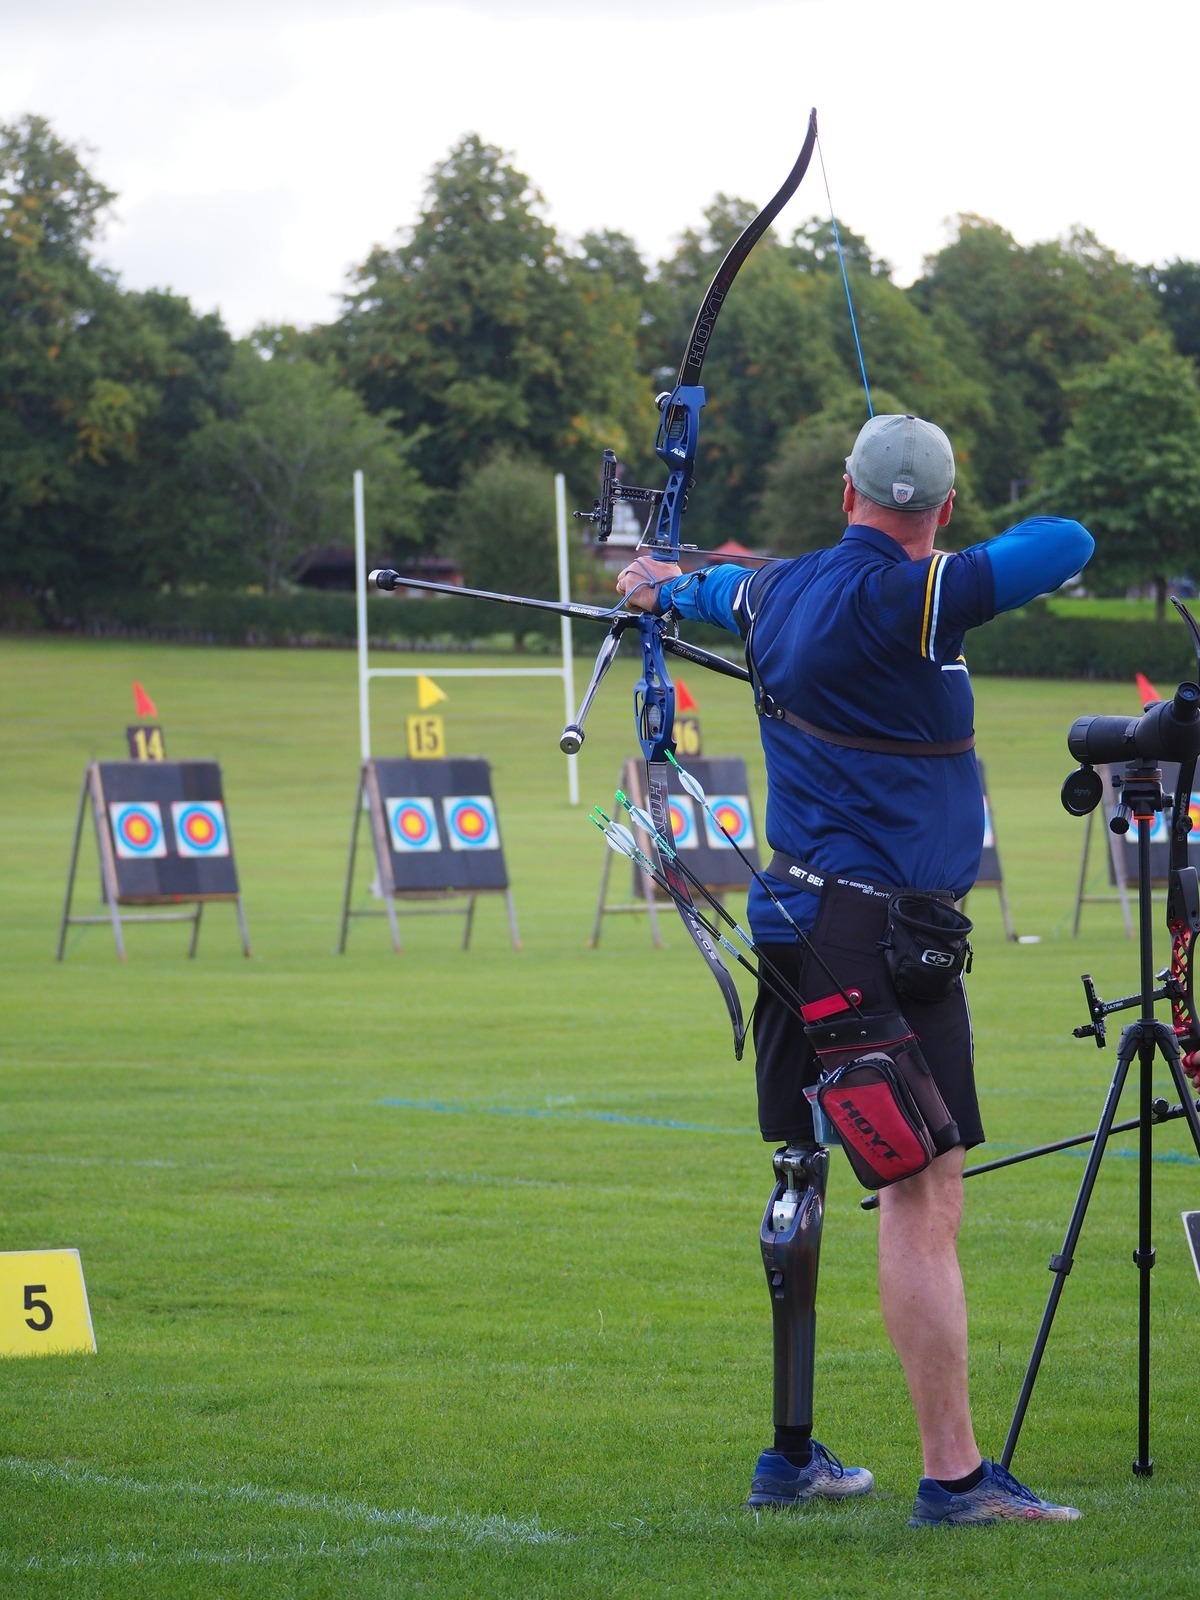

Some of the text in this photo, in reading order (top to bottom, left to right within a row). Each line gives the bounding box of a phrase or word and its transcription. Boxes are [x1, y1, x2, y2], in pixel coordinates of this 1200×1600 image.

[688, 285, 724, 368] HOYT
[134, 728, 164, 762] 14
[414, 721, 439, 752] 15
[673, 721, 699, 755] 16
[788, 865, 808, 880] GET
[837, 878, 850, 887] GET
[840, 1100, 903, 1160] HOYT
[23, 1284, 54, 1332] 5
